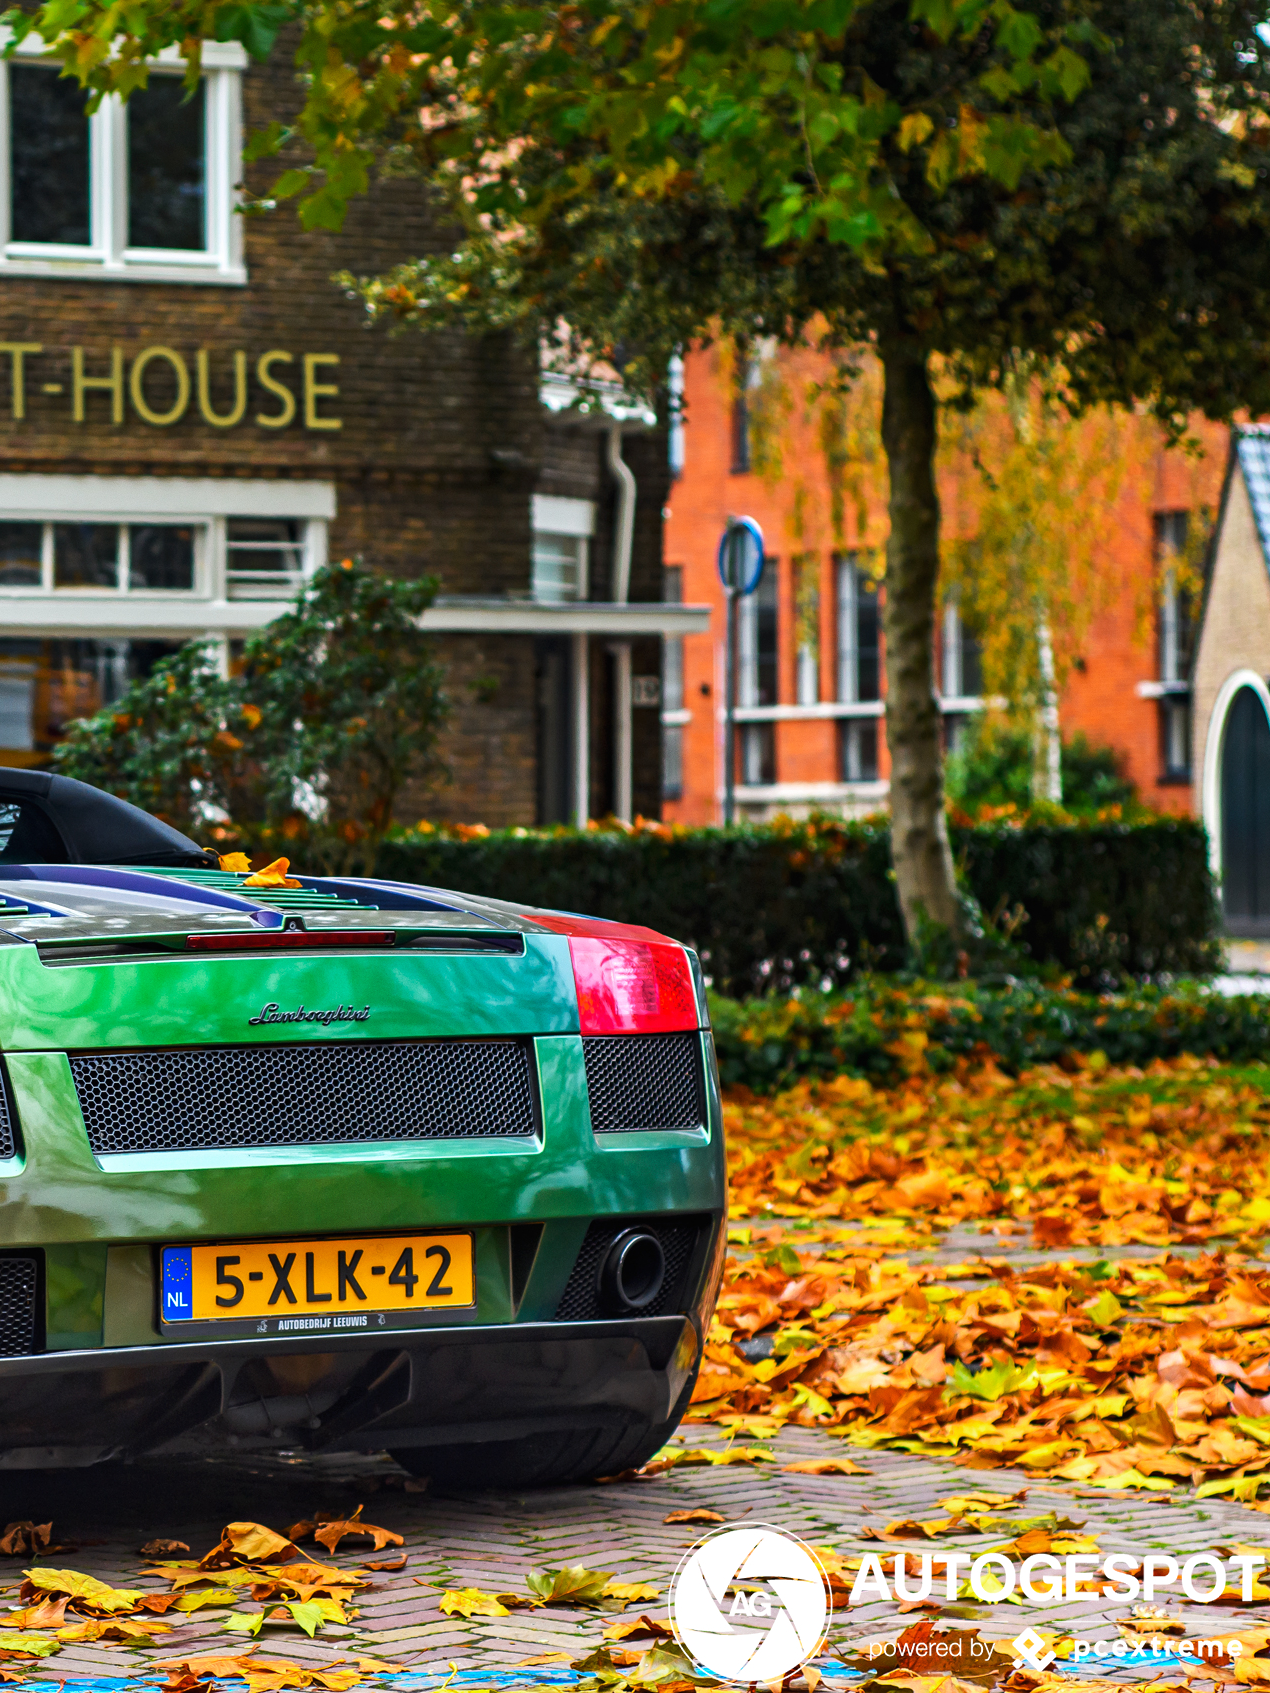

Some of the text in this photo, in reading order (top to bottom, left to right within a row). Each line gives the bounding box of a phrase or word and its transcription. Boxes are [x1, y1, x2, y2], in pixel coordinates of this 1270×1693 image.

[248, 1002, 370, 1026] Lamborghini
[216, 1245, 453, 1308] 5-XLK-42
[167, 1292, 188, 1308] NL
[278, 1316, 368, 1331] AUTOBEDRIJF LEEUWIS
